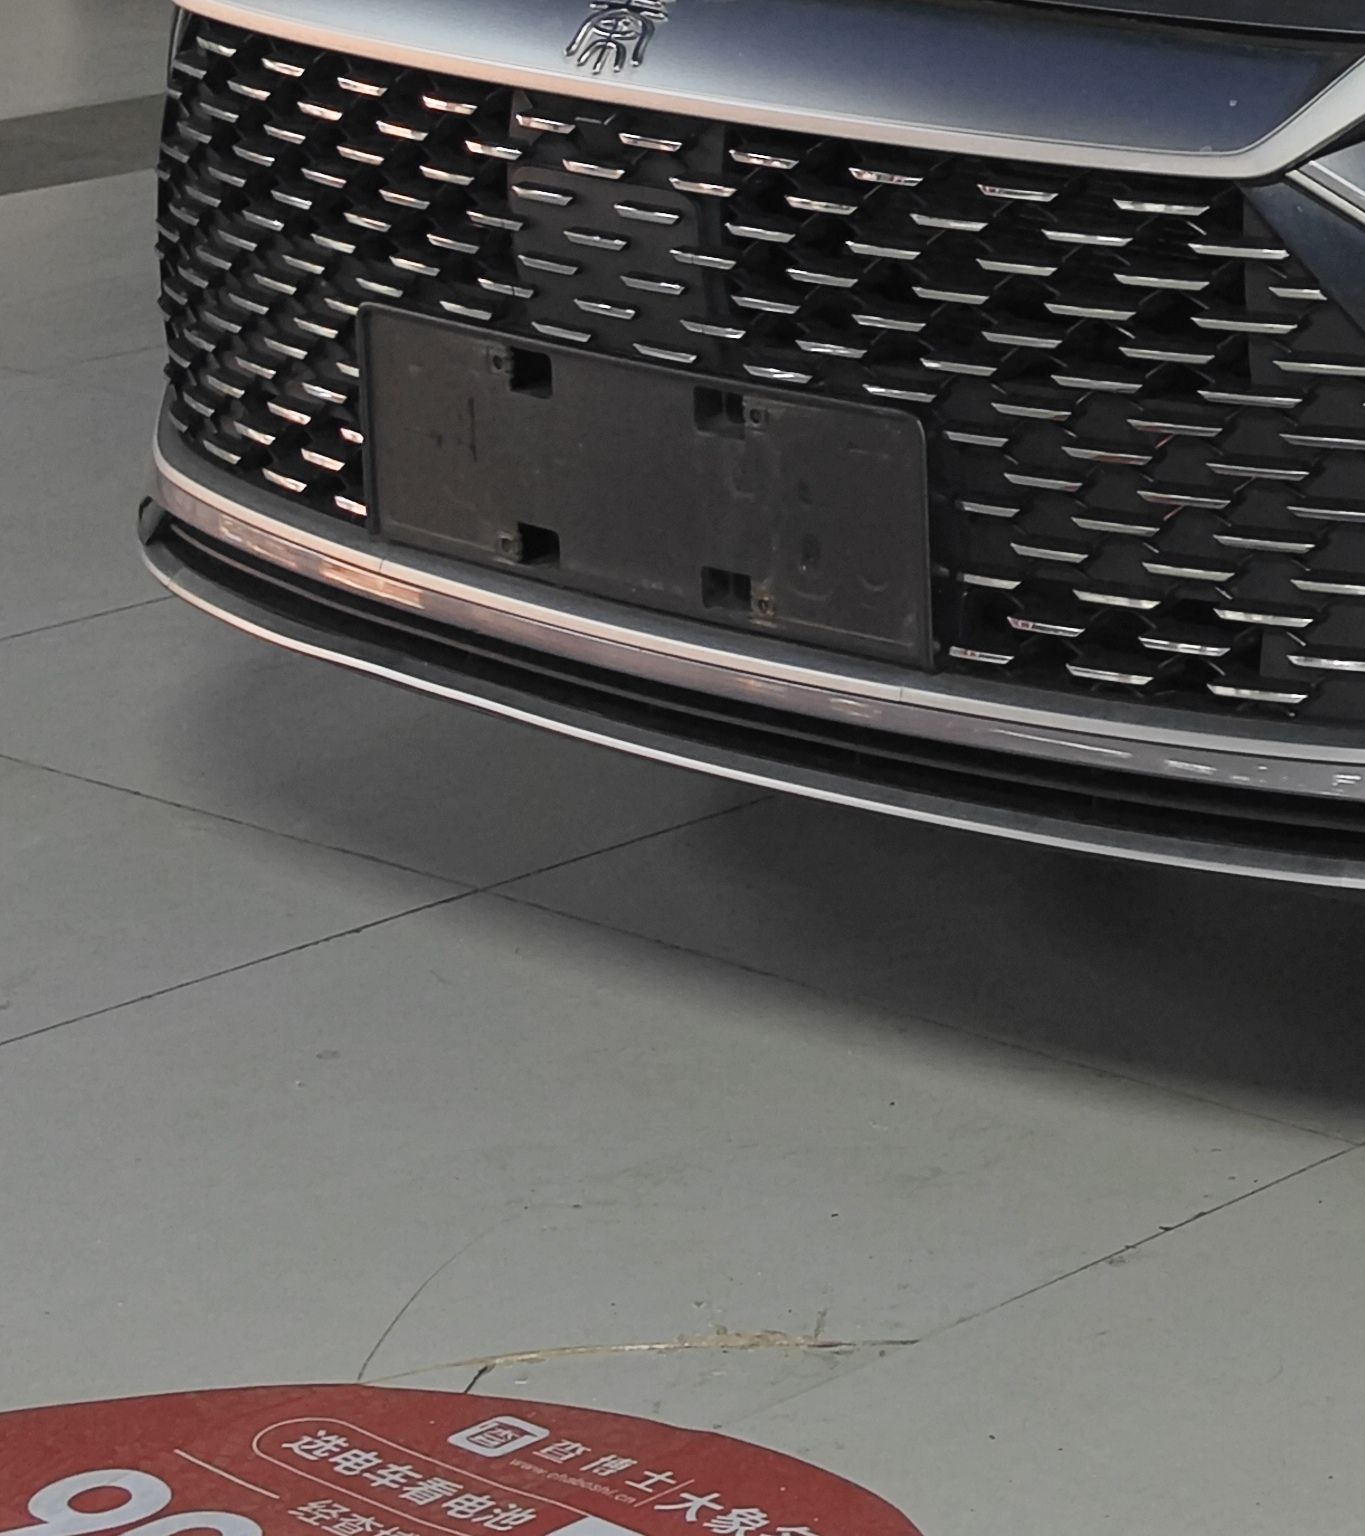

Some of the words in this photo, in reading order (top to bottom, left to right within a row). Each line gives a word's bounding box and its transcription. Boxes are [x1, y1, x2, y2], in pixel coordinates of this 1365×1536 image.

[281, 1430, 537, 1531] 选电车看电池
[532, 1439, 677, 1492] 查博士
[288, 1500, 421, 1536] 经查
